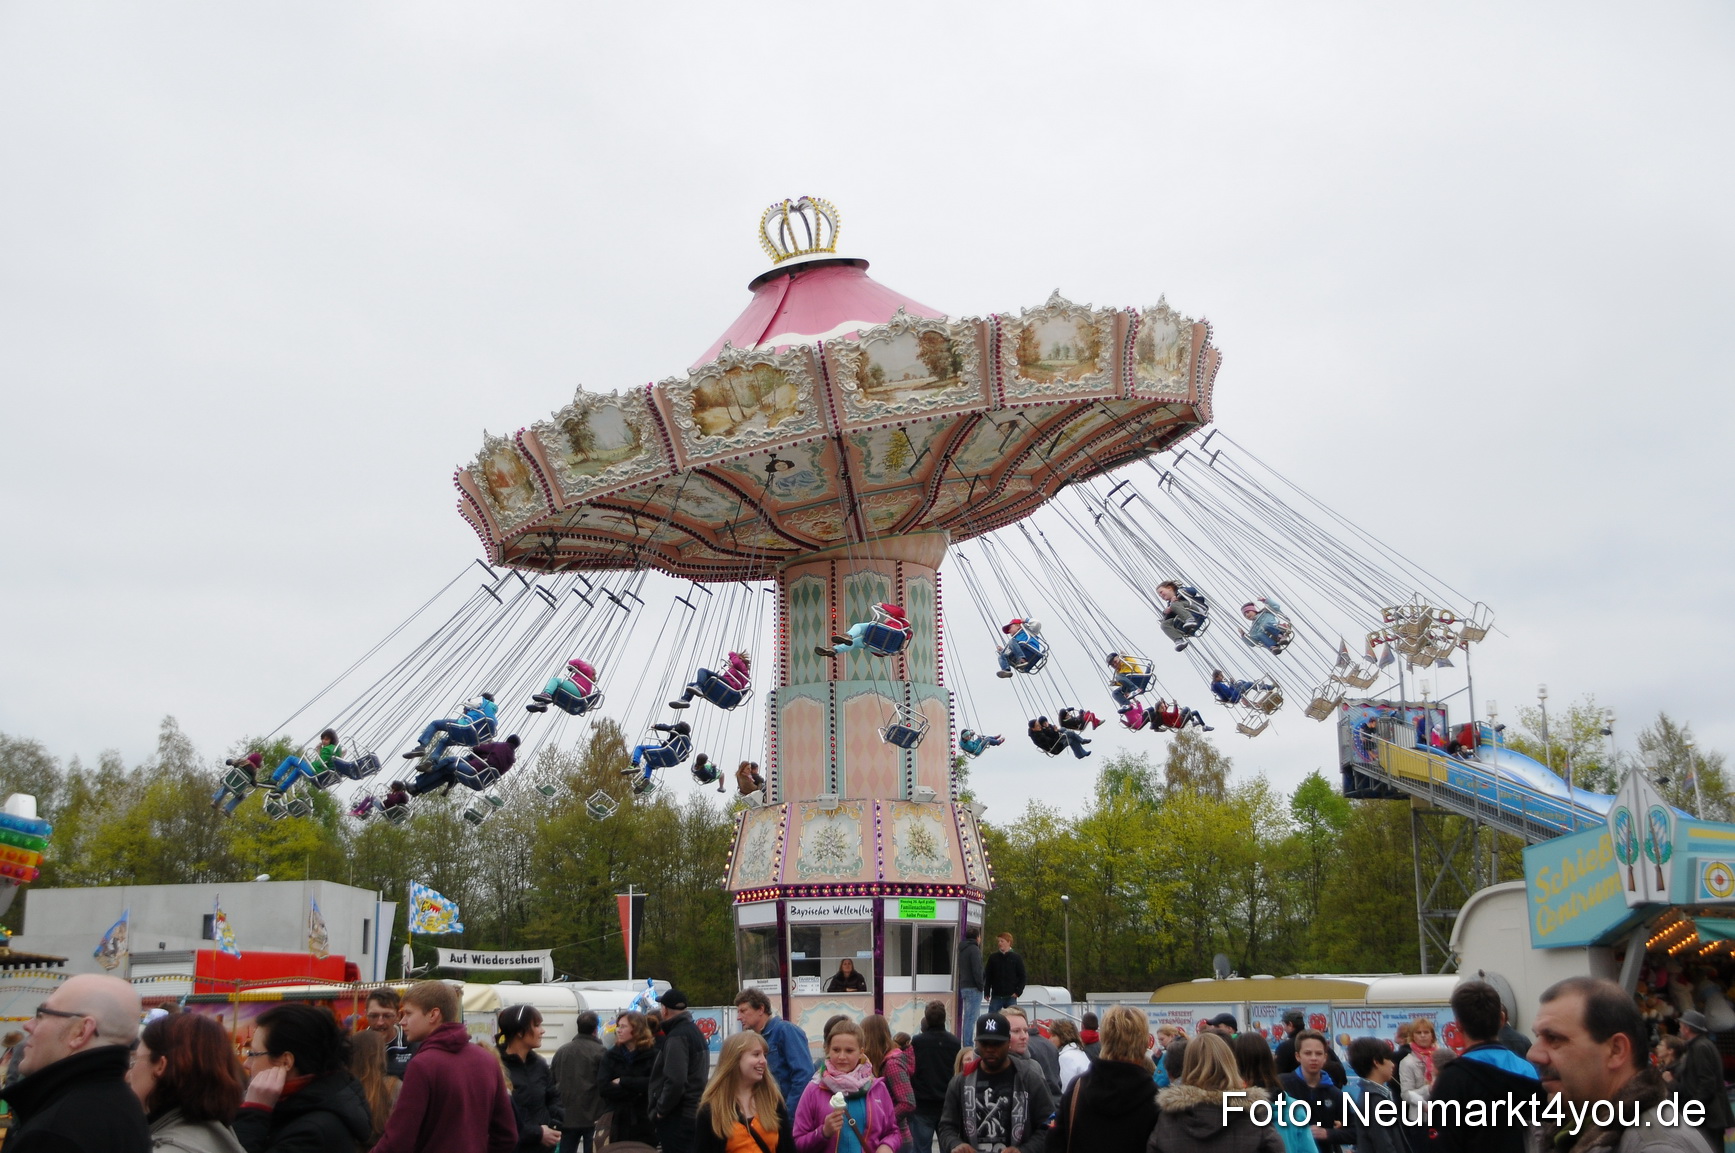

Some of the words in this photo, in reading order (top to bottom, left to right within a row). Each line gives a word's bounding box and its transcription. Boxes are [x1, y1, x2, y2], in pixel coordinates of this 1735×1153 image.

[1535, 833, 1614, 904] Schieß
[790, 905, 830, 917] Bayrischer
[1536, 872, 1624, 936] Centrum
[449, 953, 467, 963] Auf
[471, 954, 540, 965] Wiedersehen
[1251, 1005, 1277, 1017] VOLKSFEST
[1333, 1010, 1382, 1028] VOLKSFEST
